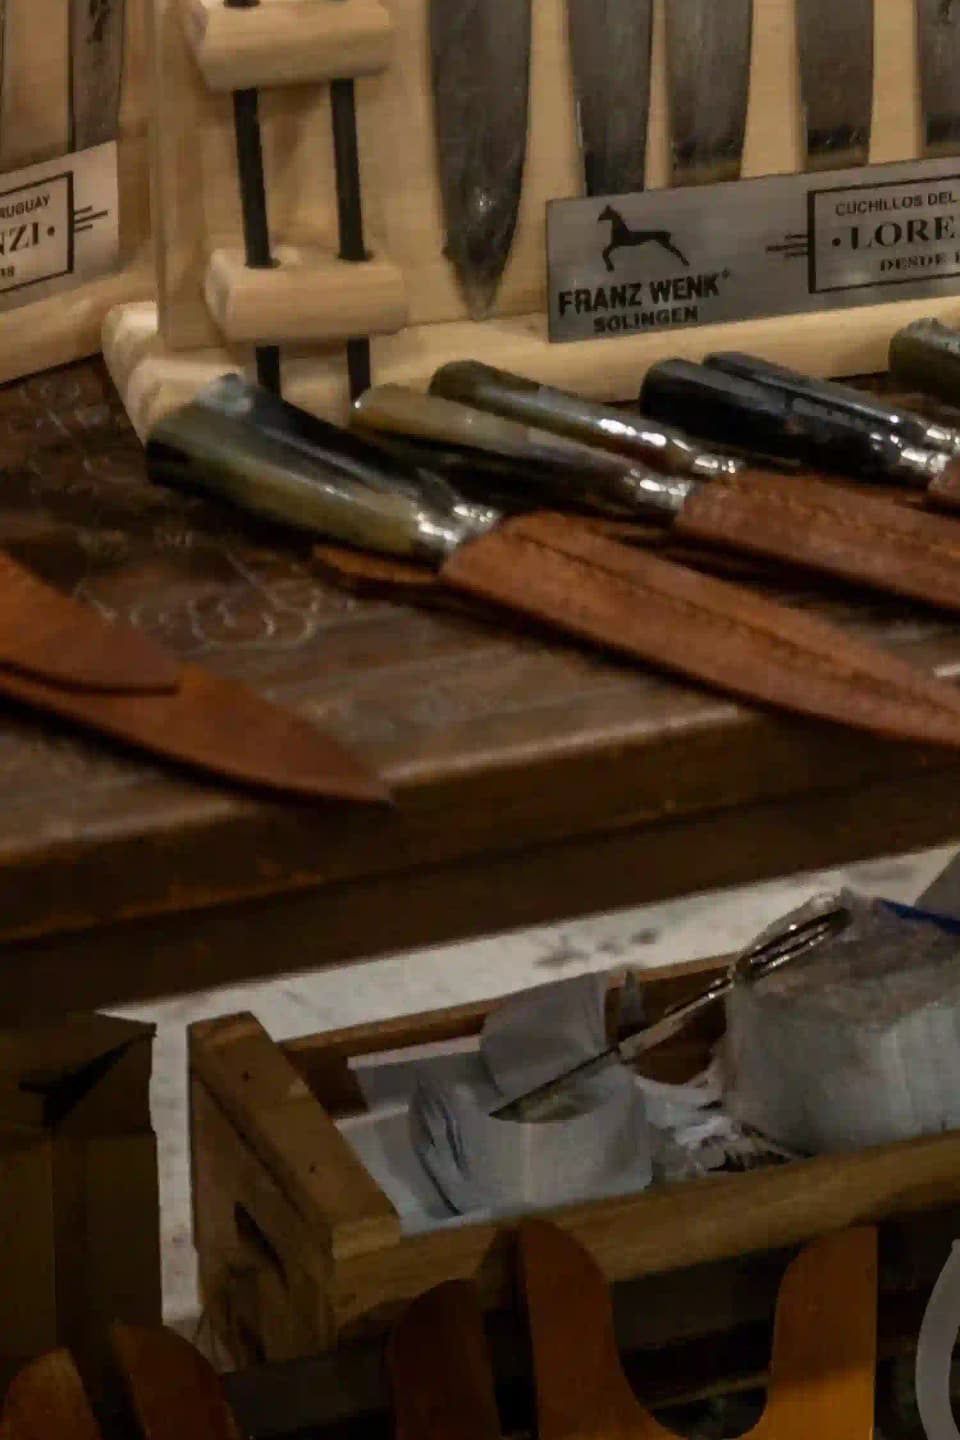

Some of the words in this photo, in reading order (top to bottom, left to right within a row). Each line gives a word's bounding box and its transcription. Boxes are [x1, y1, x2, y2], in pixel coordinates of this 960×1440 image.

[835, 194, 924, 217] CUCHILLOS
[927, 190, 958, 207] DEL
[879, 251, 947, 272] DESDE
[557, 282, 642, 317] FRANZ
[593, 305, 699, 334] SOLINGEN
